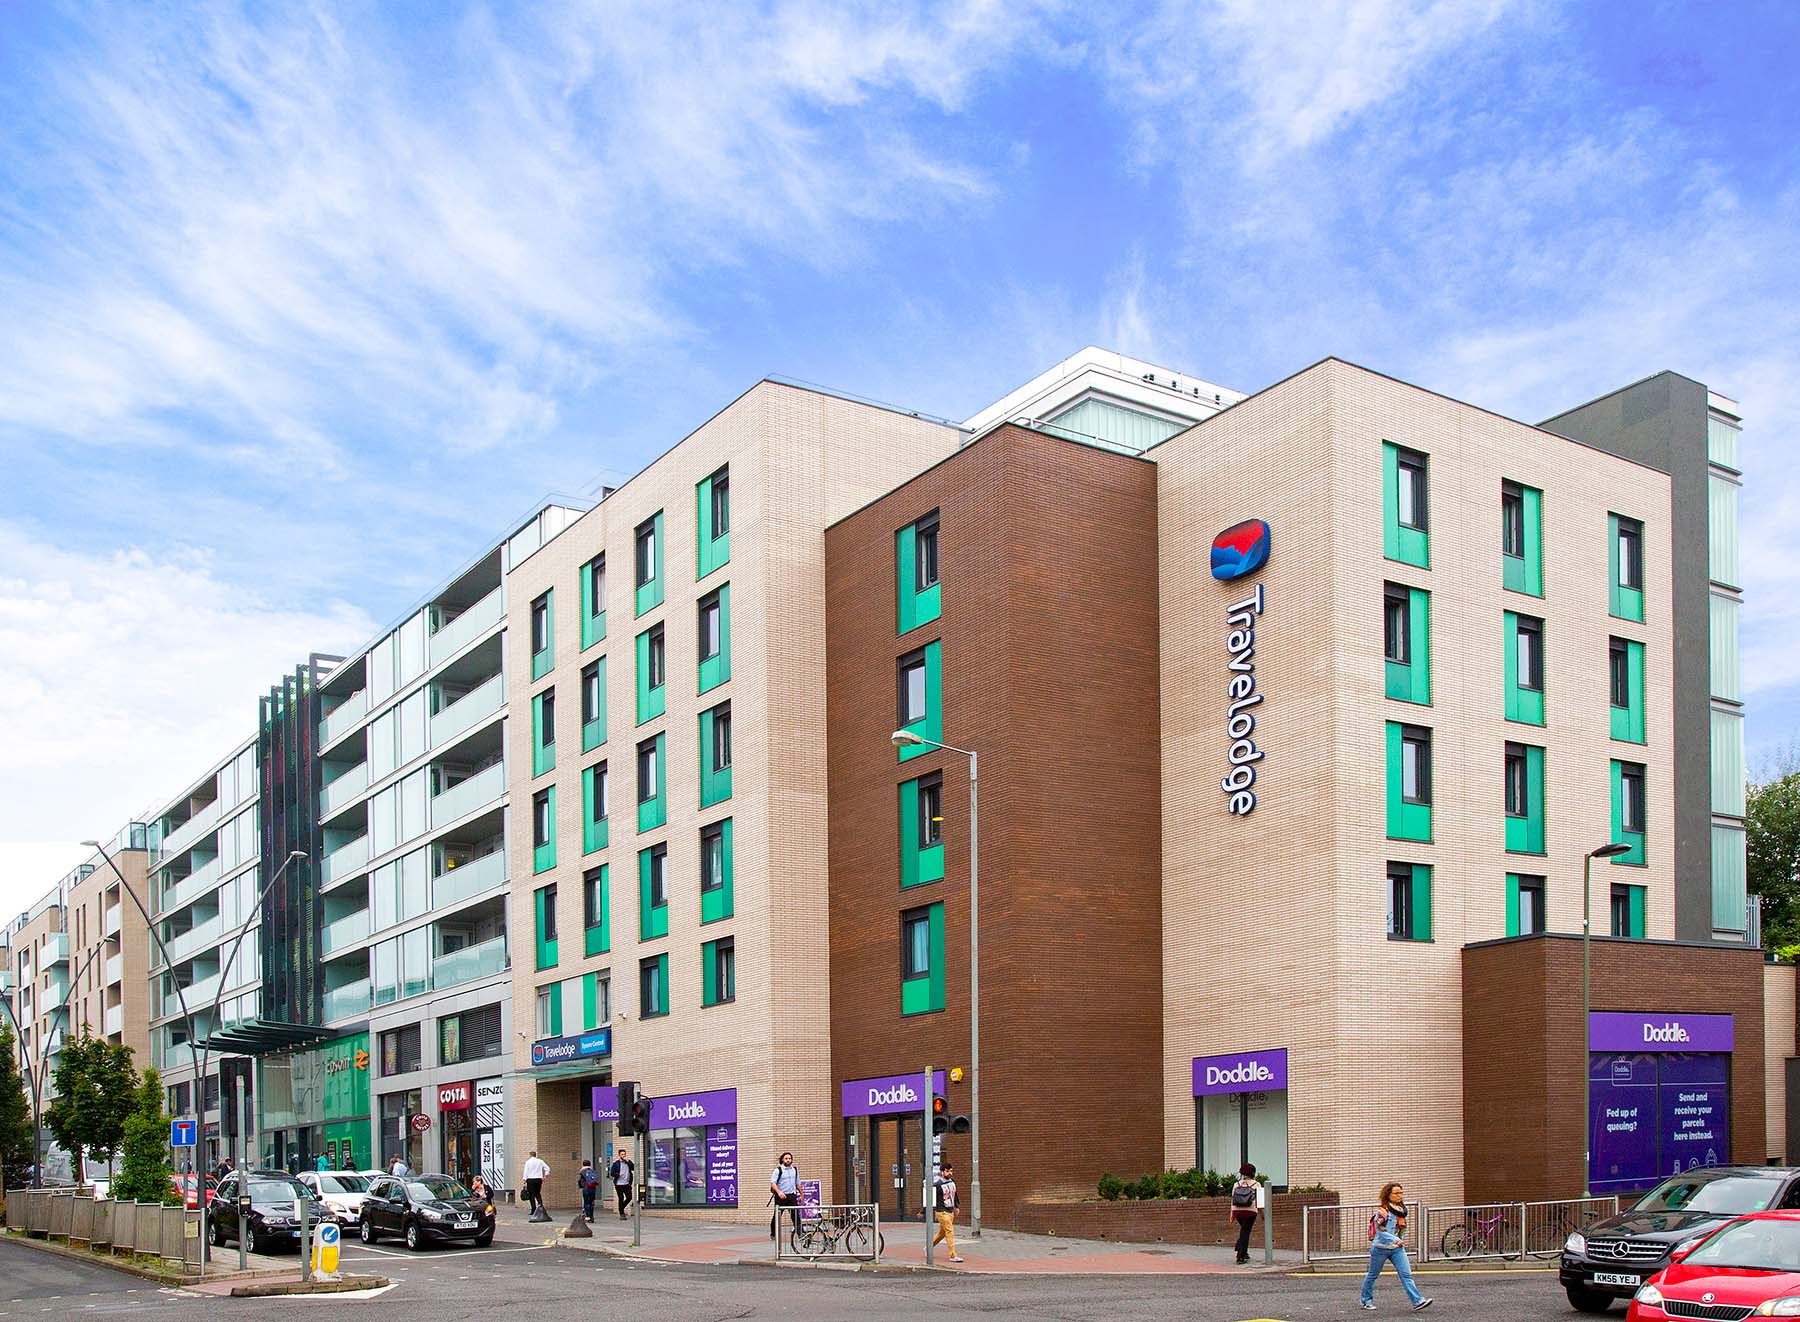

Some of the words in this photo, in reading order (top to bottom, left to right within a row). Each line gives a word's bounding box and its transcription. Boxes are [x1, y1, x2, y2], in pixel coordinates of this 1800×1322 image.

[1221, 583, 1265, 816] Travelodge
[1643, 1022, 1690, 1043] Doddle.
[544, 1042, 576, 1058] Travelodge
[1206, 1060, 1274, 1086] Doddle.
[440, 1087, 466, 1104] COSTA
[868, 1083, 918, 1106] Doddle.
[1678, 1092, 1695, 1102] Send
[1695, 1092, 1708, 1101] and
[668, 1100, 707, 1121] Doddle.
[1606, 1108, 1619, 1118] Fed
[1620, 1109, 1630, 1119] up
[1631, 1107, 1638, 1117] of
[1674, 1106, 1697, 1115] receive
[1697, 1106, 1713, 1116] your
[1606, 1121, 1638, 1133] queuing?
[1682, 1118, 1705, 1129] parcels
[1673, 1131, 1688, 1141] here
[1688, 1130, 1714, 1140] instead.
[1597, 1274, 1617, 1283] KM56
[1619, 1275, 1637, 1284] YEJ
